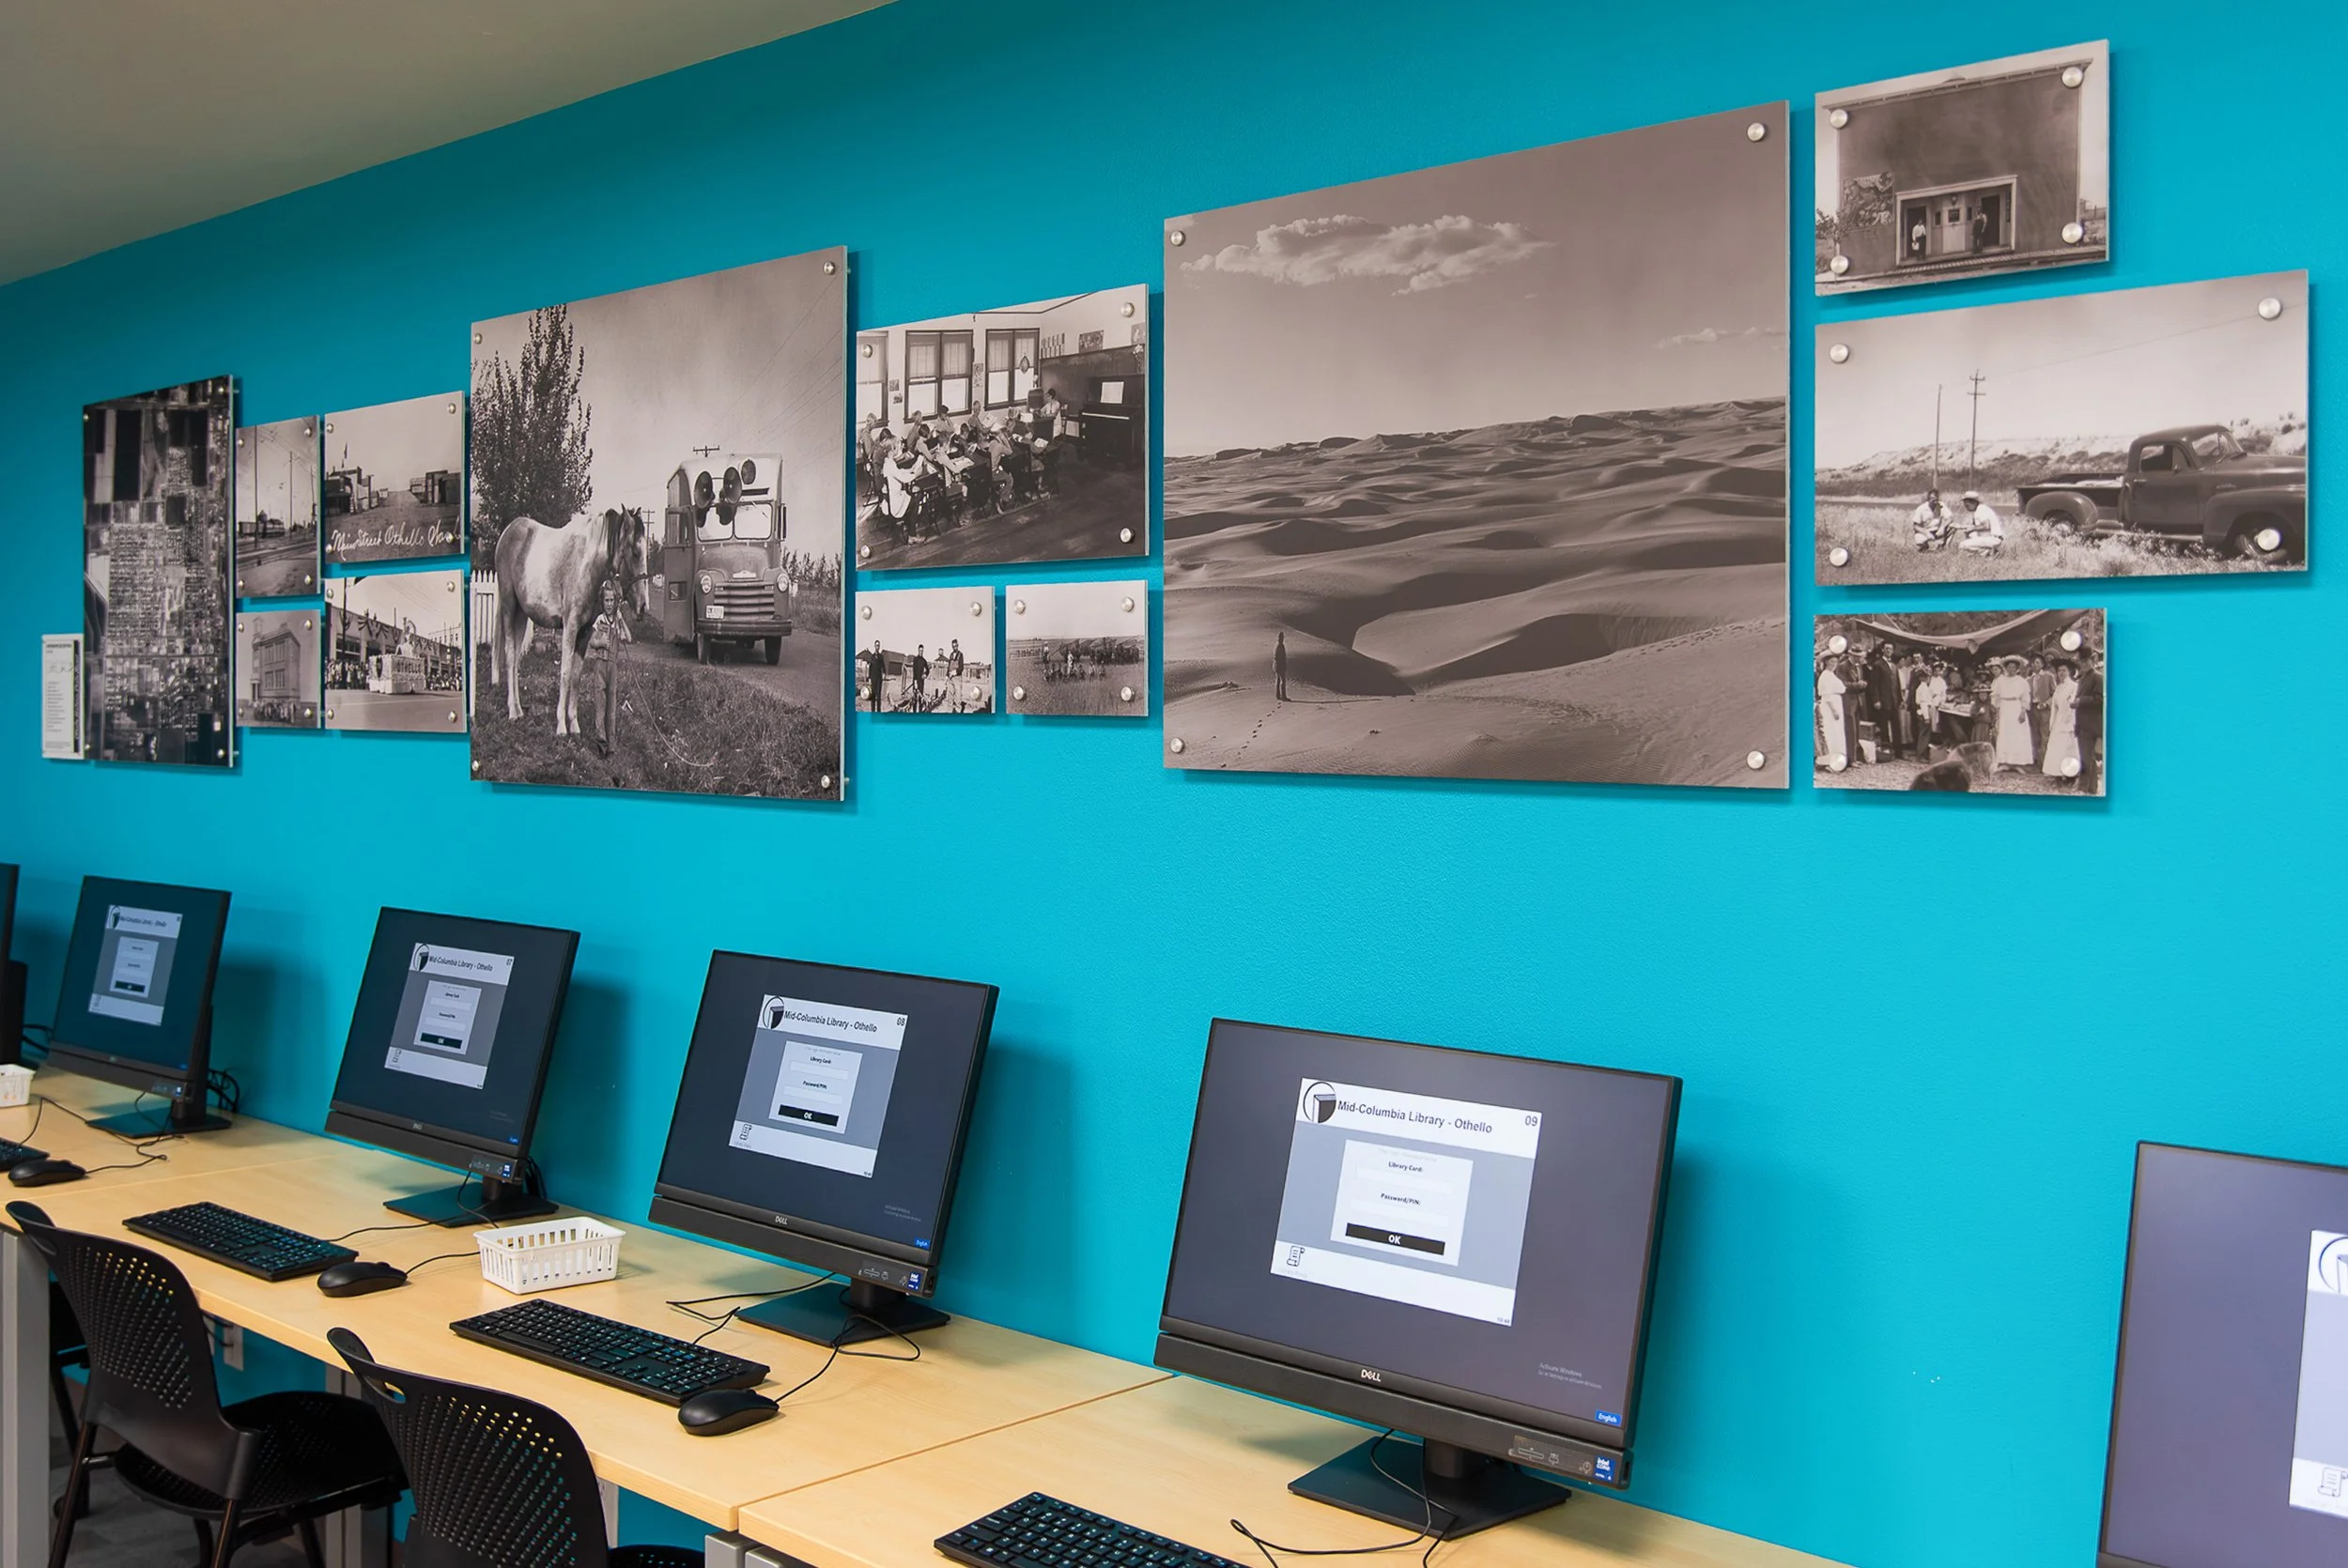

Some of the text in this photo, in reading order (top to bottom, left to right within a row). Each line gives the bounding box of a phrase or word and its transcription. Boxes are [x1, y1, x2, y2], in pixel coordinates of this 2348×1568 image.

[356, 529, 382, 546] Street
[384, 521, 425, 546] Othello
[457, 960, 473, 971] Library
[783, 1010, 826, 1024] Mid-Columbia
[826, 1017, 849, 1030] Library
[854, 1021, 878, 1033] Othello
[1336, 1099, 1406, 1121] Mid-Columbia
[1409, 1111, 1445, 1129] Library
[1454, 1117, 1493, 1134] Othello
[1524, 1115, 1538, 1127] 09
[1388, 1161, 1408, 1172] Library
[775, 1215, 788, 1225] DELL
[1388, 1235, 1401, 1245] OK
[1361, 1368, 1382, 1383] DELL
[1598, 1412, 1617, 1424] English
